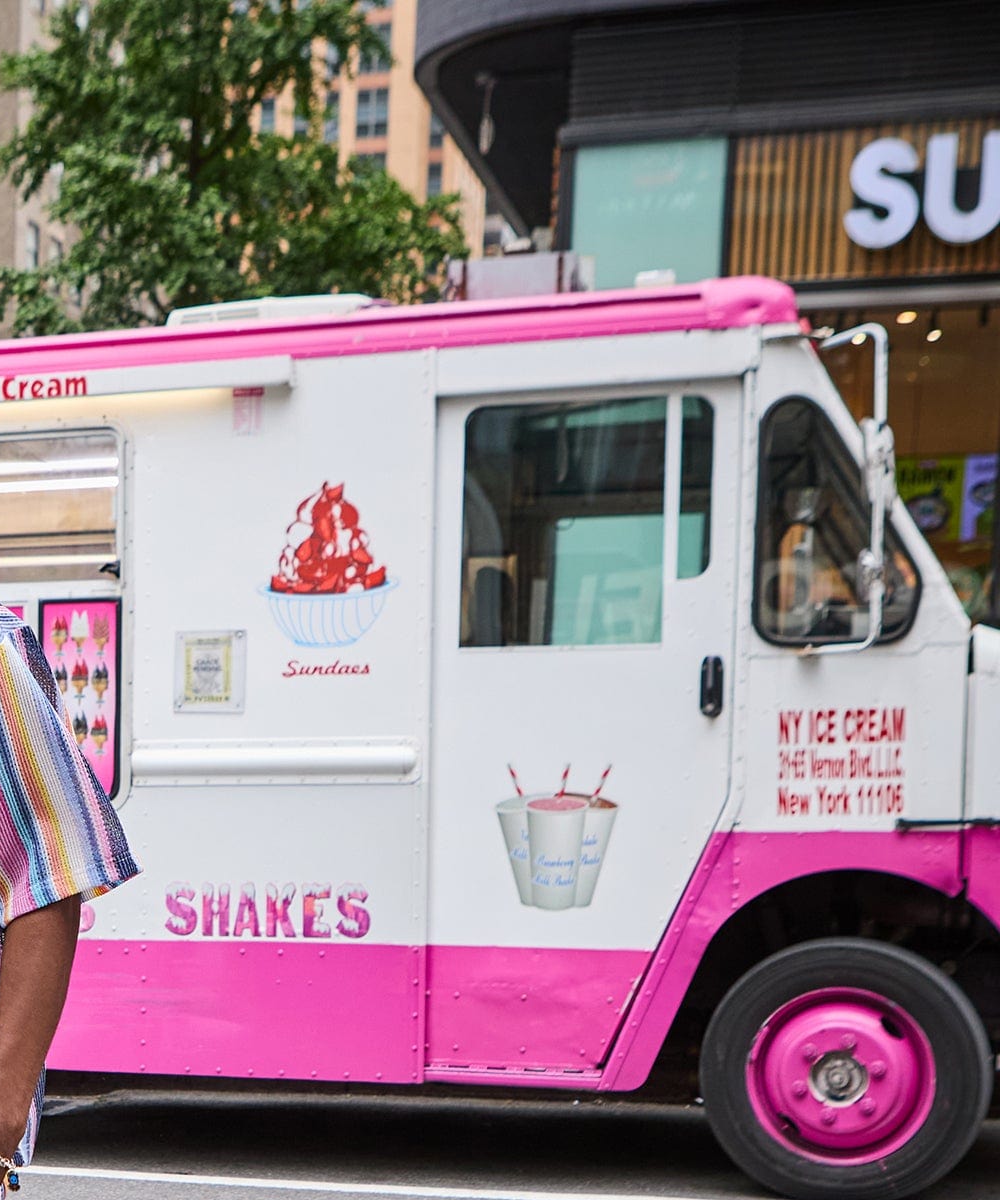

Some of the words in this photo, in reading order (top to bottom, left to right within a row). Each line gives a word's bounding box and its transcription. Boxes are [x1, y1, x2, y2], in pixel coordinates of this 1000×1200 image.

[843, 130, 1000, 249] SU
[2, 376, 88, 401] Cream
[282, 659, 370, 678] Sundaes
[778, 709, 803, 743] NY
[808, 709, 836, 743] ICE
[844, 707, 906, 742] CREAM
[777, 786, 811, 815] New
[815, 785, 851, 815] York
[164, 881, 372, 939] SHAKES
